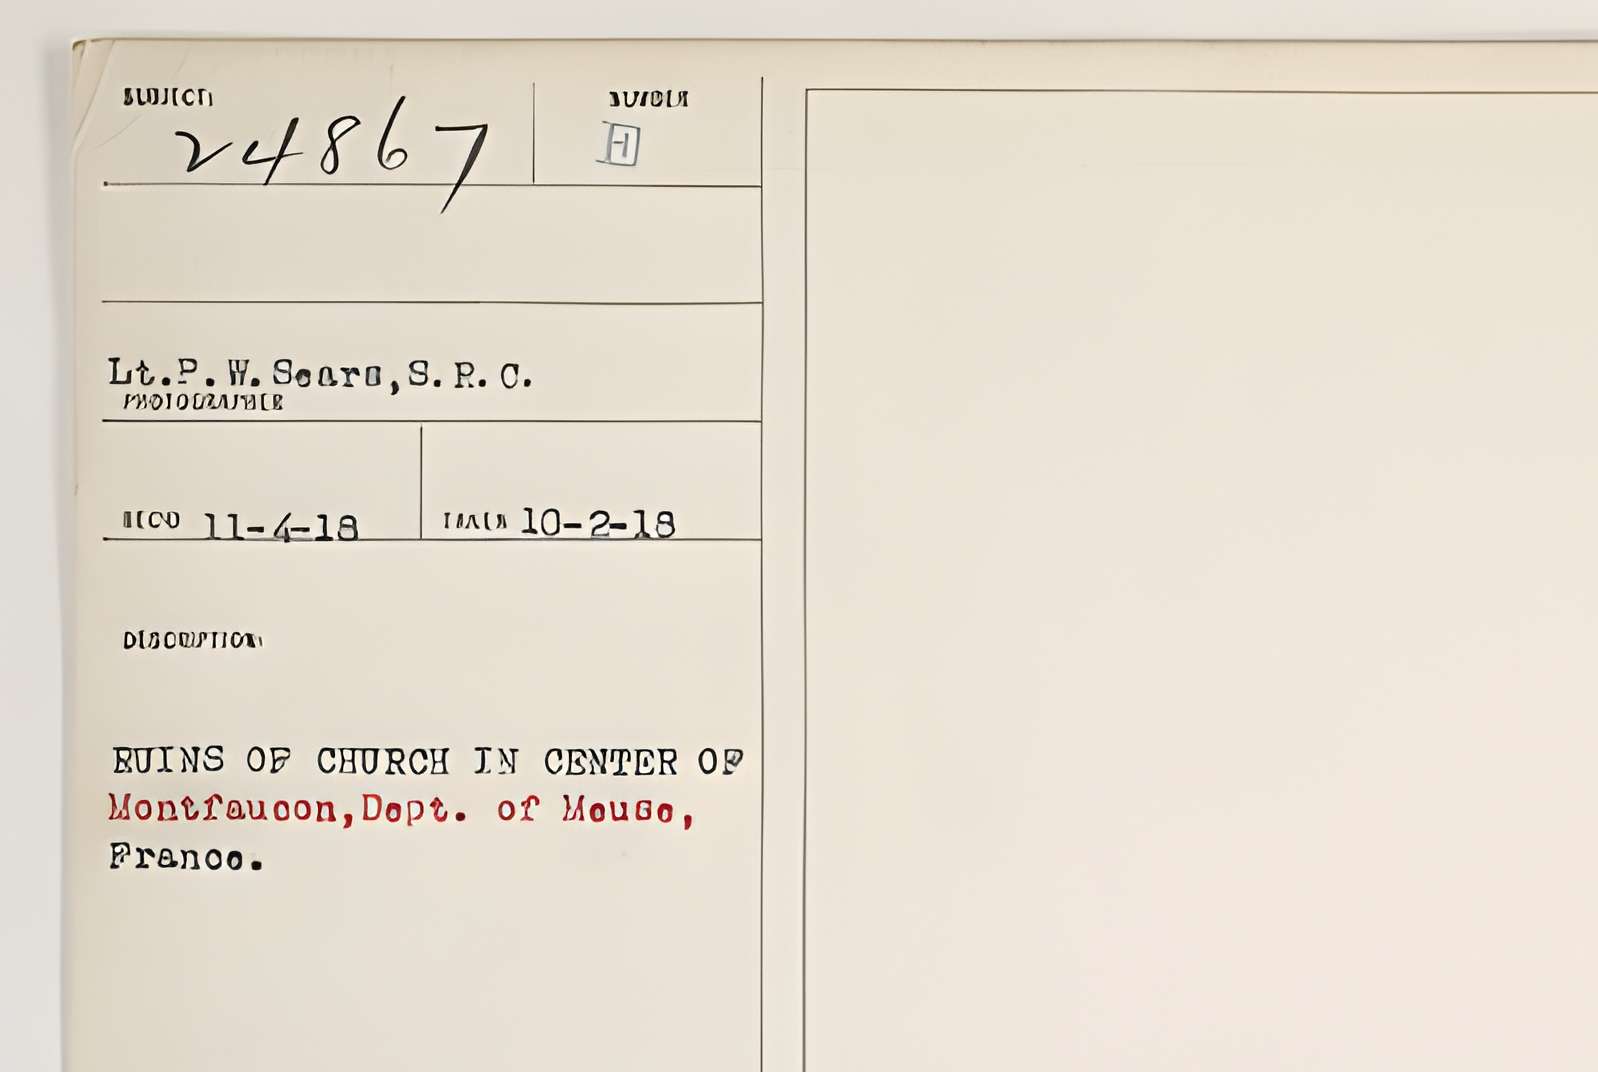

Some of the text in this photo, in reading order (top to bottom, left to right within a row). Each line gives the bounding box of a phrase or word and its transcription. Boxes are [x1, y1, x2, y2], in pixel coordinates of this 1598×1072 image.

[174, 96, 488, 214] 24867
[204, 512, 360, 543] 11-4-18
[521, 507, 676, 538] 10-2-18
[112, 744, 745, 777] RUINS OF CHURCH IN CENTER OF
[497, 794, 541, 822] of
[109, 841, 263, 871] France.
